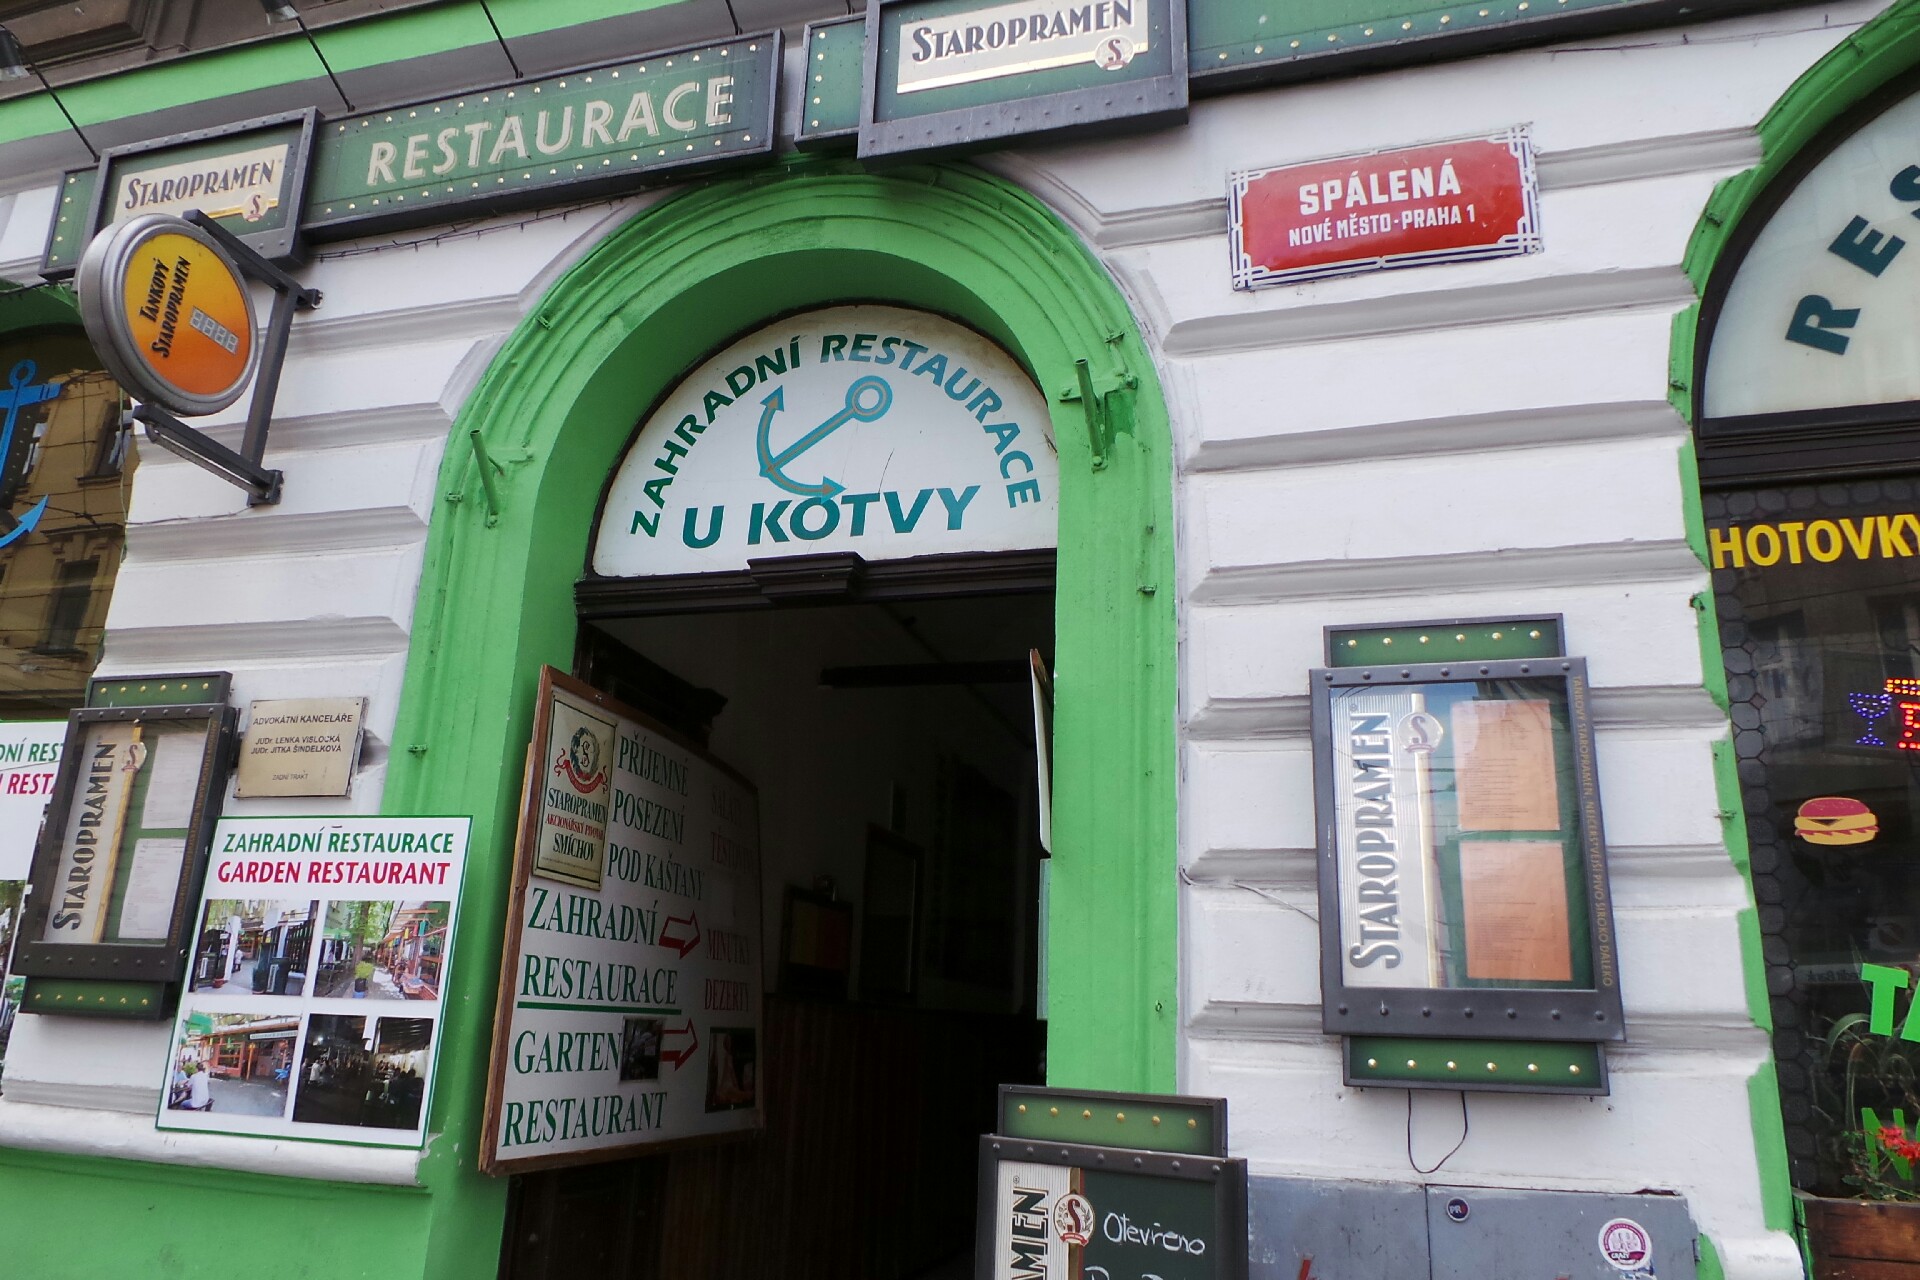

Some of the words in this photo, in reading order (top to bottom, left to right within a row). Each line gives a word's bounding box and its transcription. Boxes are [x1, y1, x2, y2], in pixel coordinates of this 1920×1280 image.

[911, 0, 1133, 64] STAROPRAMEN
[367, 76, 734, 186] RESTAURACE
[125, 159, 275, 210] STAROPRAMEN
[1298, 157, 1462, 217] SPÁLENÁ
[1289, 218, 1332, 248] NOVÉ
[1467, 204, 1476, 226] 1
[139, 257, 170, 323] TANKOVÝ
[152, 255, 192, 358] STAROPRAMEN
[631, 336, 802, 538] ZAHRADNÍ
[820, 333, 1042, 509] RESTAURACE
[682, 504, 725, 549] U
[747, 485, 981, 546] KOTVY
[252, 714, 299, 725] ADVOKÁTNÍ
[299, 712, 353, 723] KANCELÁŘE
[275, 736, 300, 744] LENKA
[28, 743, 64, 762] RES
[618, 730, 689, 797] PŘÍJEMNÉ
[7, 773, 56, 794] REST
[547, 787, 608, 824] STAROPRAMEN
[53, 742, 117, 931] STAROPRAMEN
[222, 826, 325, 853] ZAHRADNÍ
[327, 833, 454, 854] RESTAURACE
[612, 788, 686, 845] POSEZENÍ
[1350, 712, 1401, 969] STAROPRAMEN
[217, 861, 302, 884] GARDEN
[307, 861, 451, 885] RESTAURANT
[553, 833, 596, 861] SMÍCHOV
[607, 843, 642, 883] POD
[643, 852, 705, 900] KAŠTANY
[527, 887, 659, 946] ZAHRADNÍ
[520, 954, 678, 1006] RESTAURACE
[514, 1030, 623, 1074] GARTEN
[502, 1092, 668, 1147] RESTAURANT
[1010, 1187, 1049, 1280] MEN
